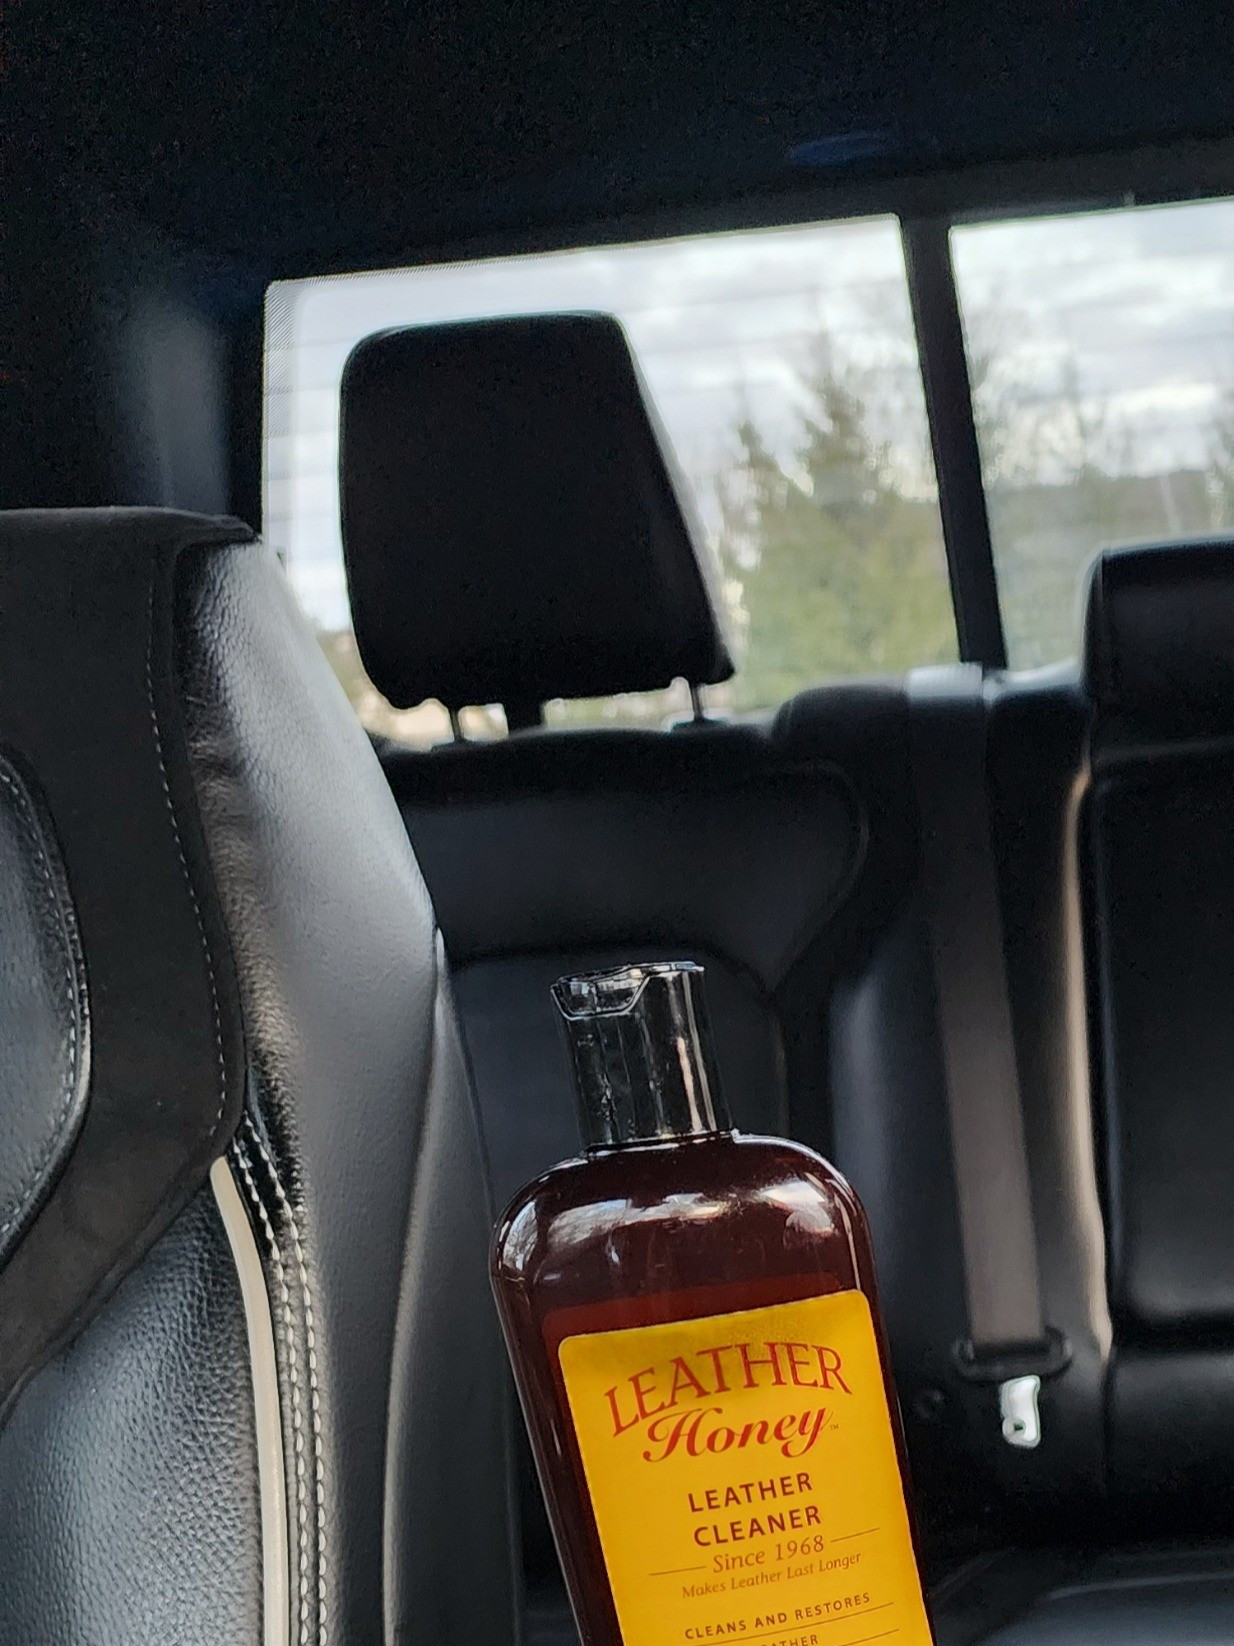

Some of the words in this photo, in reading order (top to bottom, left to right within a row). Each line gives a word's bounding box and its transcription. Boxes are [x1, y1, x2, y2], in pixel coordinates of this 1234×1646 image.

[605, 1342, 852, 1437] LEATHER
[643, 1408, 833, 1462] Honey
[688, 1472, 813, 1512] LEATHER
[694, 1505, 821, 1546] CLEANER
[682, 1582, 726, 1598] Makes
[731, 1570, 782, 1589] Leather
[787, 1565, 814, 1580] Last
[819, 1553, 861, 1572] Longer
[713, 1550, 766, 1573] Since
[775, 1535, 825, 1561] 1968
[685, 1620, 747, 1640] CLEANS
[755, 1612, 787, 1628] AND
[795, 1592, 870, 1619] RESTORES
